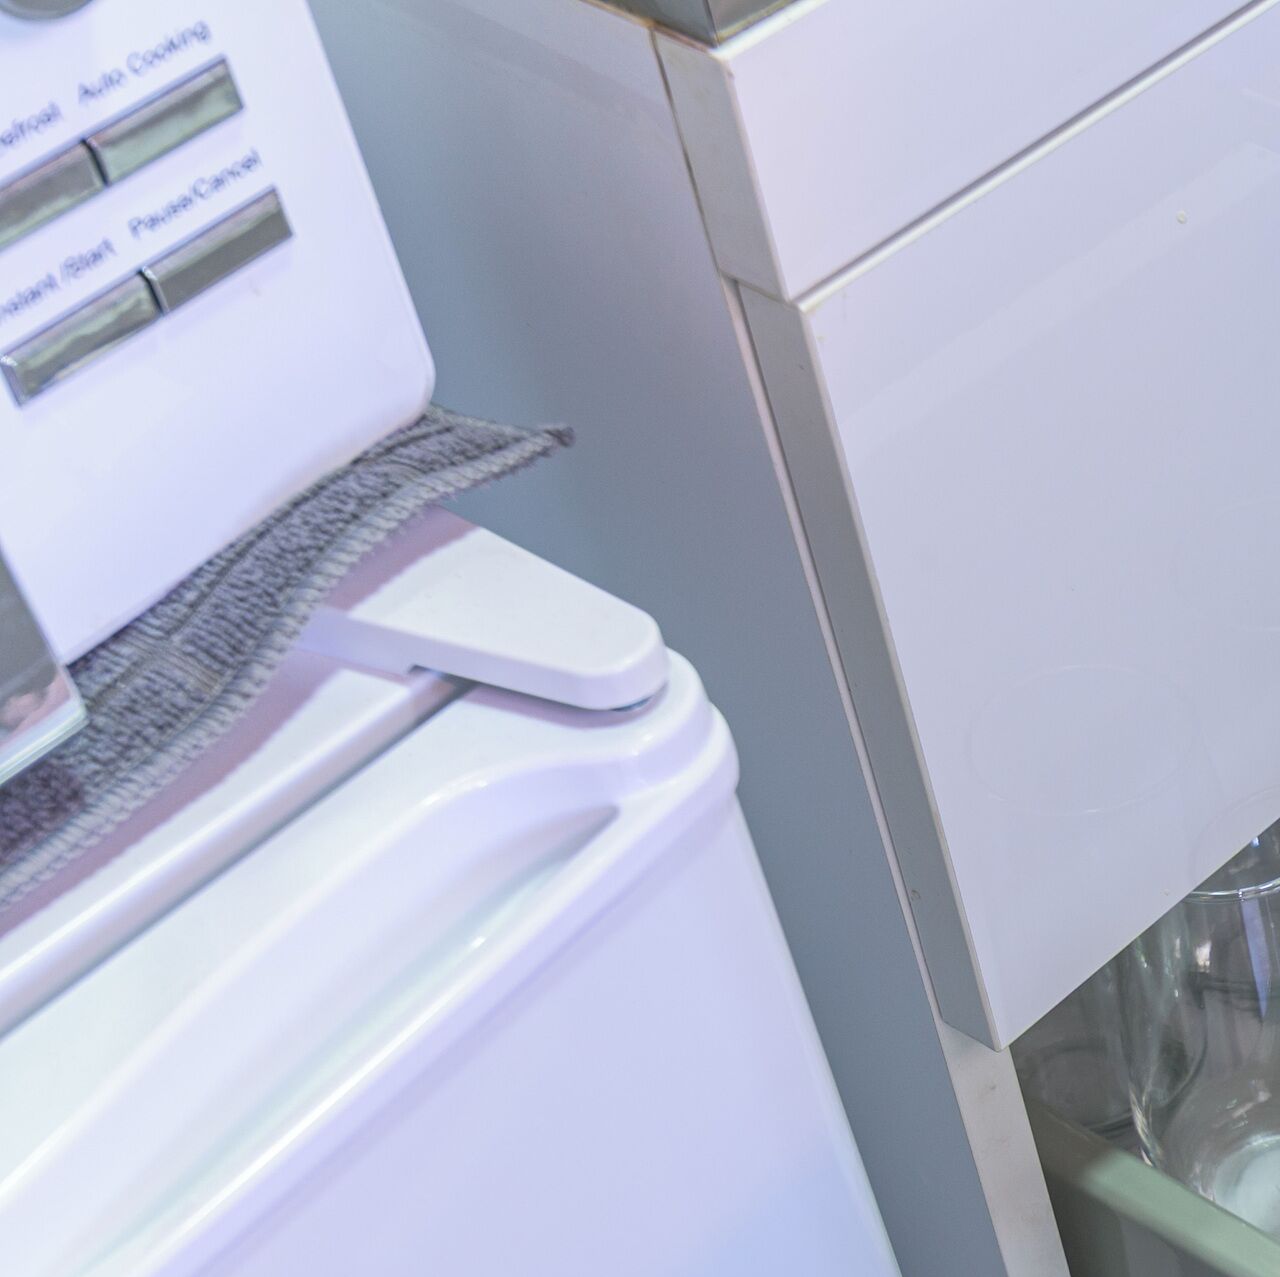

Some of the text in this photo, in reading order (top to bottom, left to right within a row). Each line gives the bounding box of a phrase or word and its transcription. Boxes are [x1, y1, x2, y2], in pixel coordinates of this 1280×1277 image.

[78, 21, 210, 104] Auto Cooking
[0, 102, 62, 146] efrost
